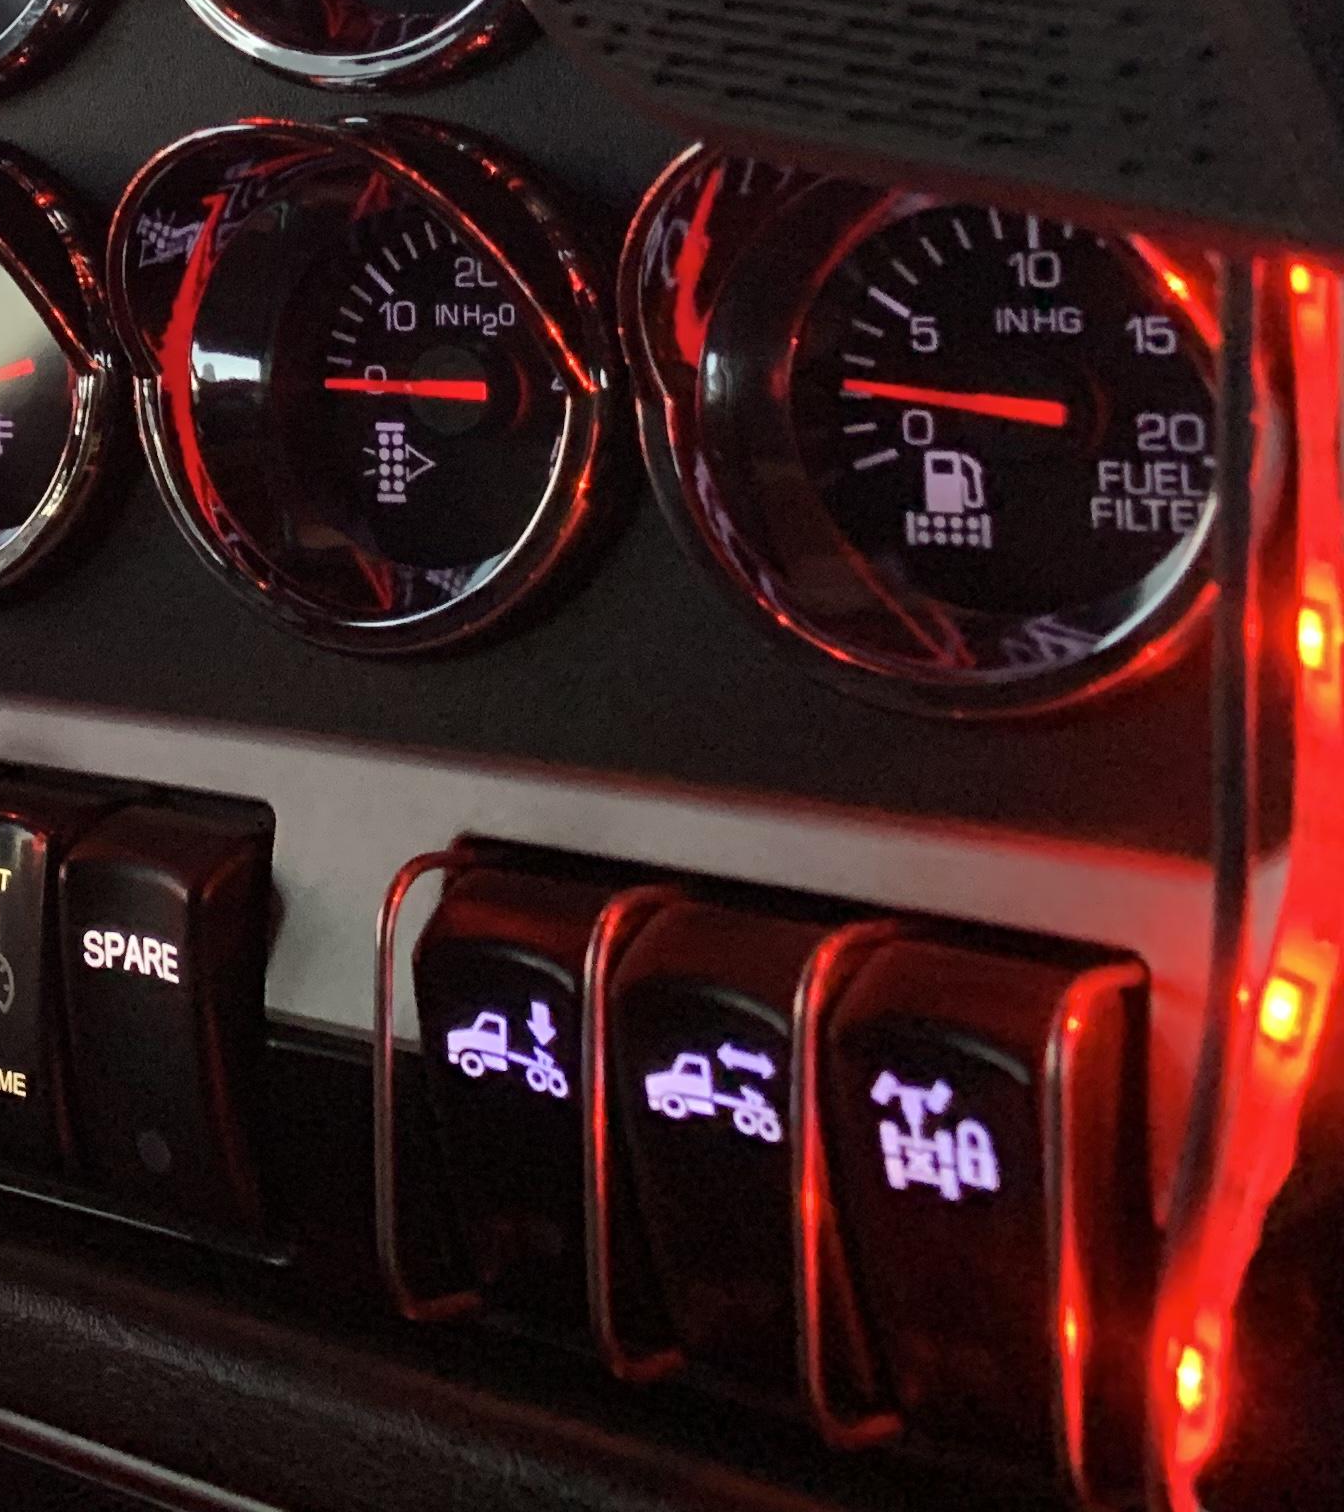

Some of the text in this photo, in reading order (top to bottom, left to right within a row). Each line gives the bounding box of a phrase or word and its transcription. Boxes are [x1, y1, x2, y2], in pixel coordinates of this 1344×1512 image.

[1006, 250, 1062, 289] 10
[378, 300, 417, 332] 10
[909, 316, 941, 353] 5
[994, 306, 1084, 335] INHG
[1124, 314, 1178, 355] 15
[901, 408, 935, 446] 0
[1135, 411, 1206, 453] 20
[1097, 459, 1204, 496] FUEL
[81, 928, 181, 985] SPARE
